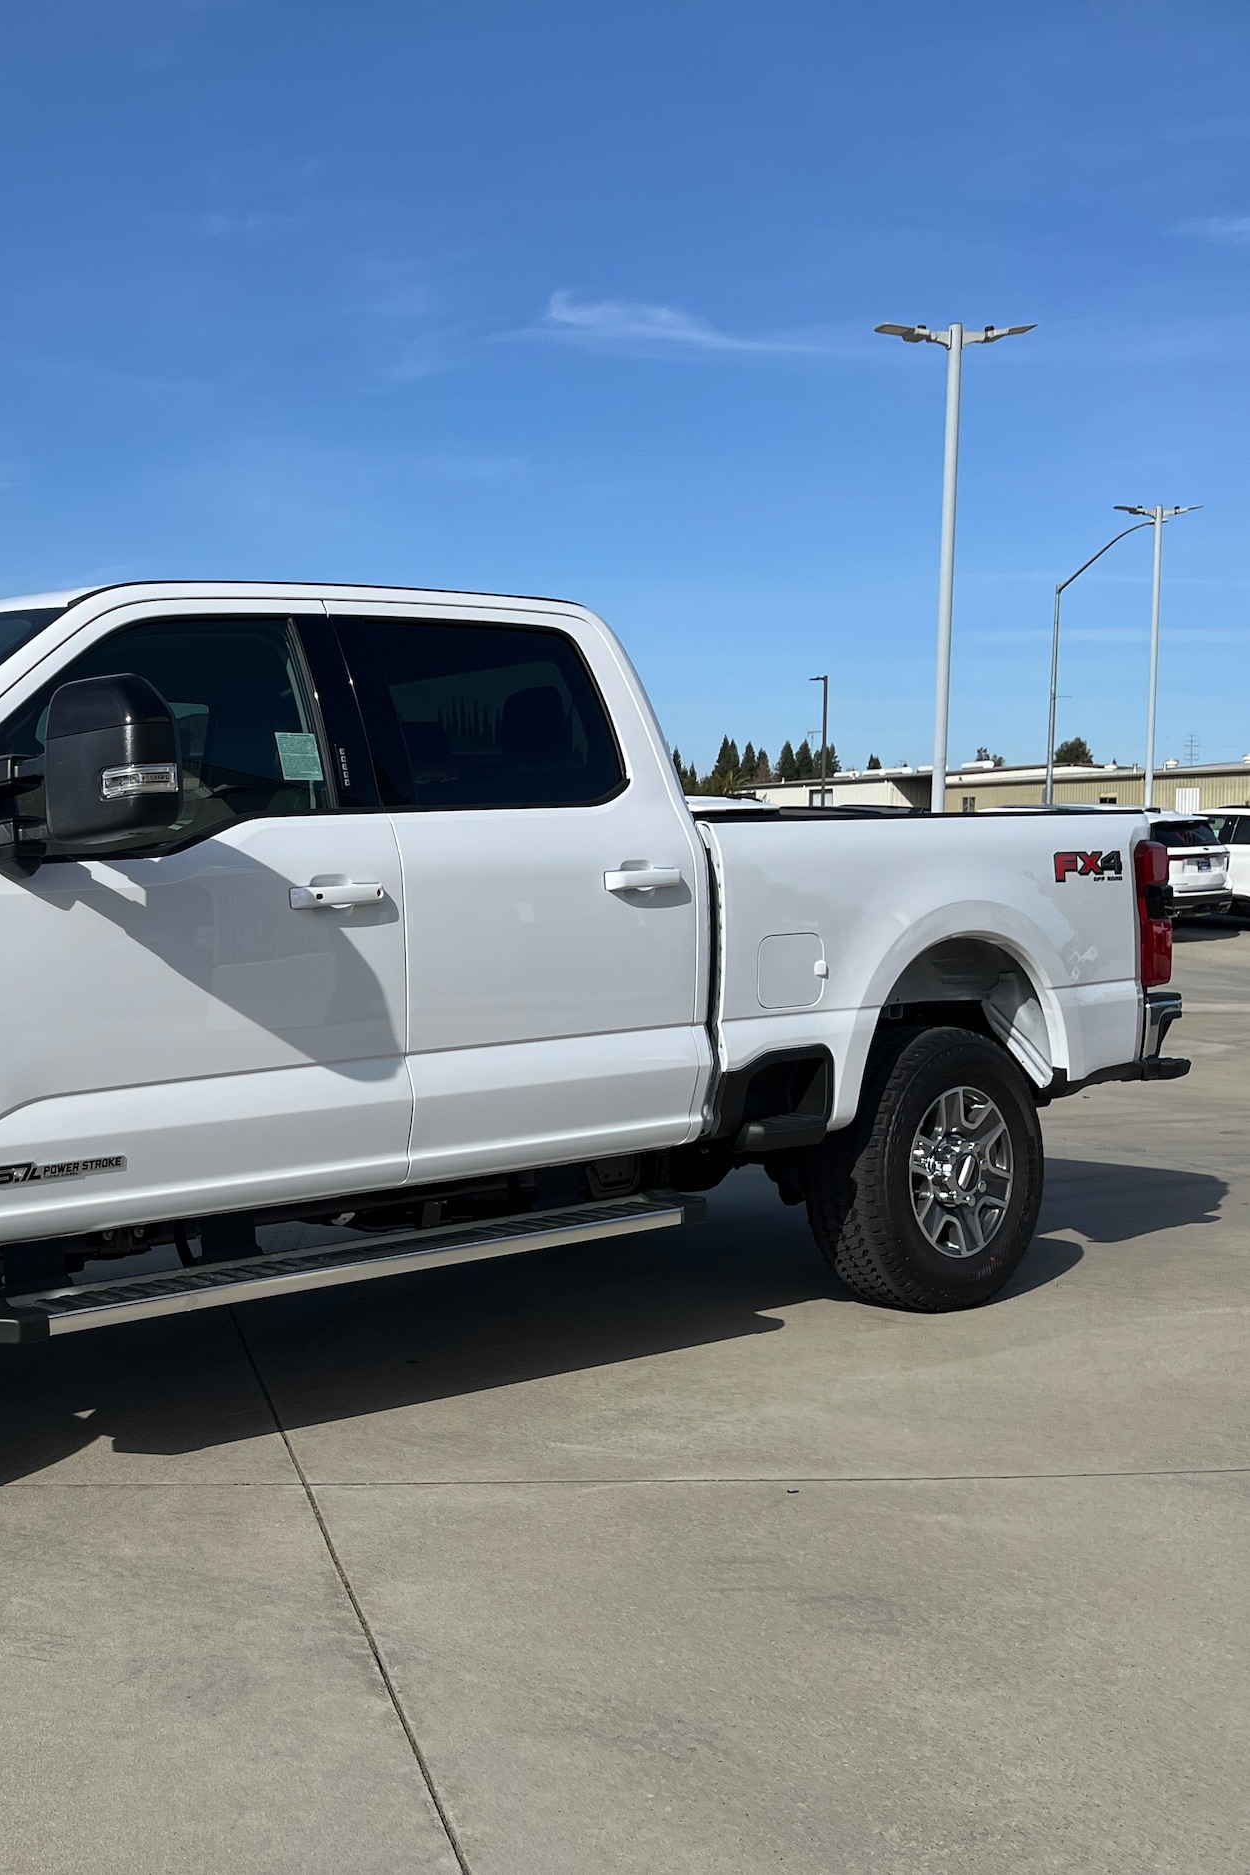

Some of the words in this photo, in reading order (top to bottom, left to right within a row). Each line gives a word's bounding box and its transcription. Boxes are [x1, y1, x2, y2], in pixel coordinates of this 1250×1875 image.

[1054, 851, 1123, 883] FX4
[43, 1162, 80, 1175] POWER
[82, 1156, 122, 1170] STROKE
